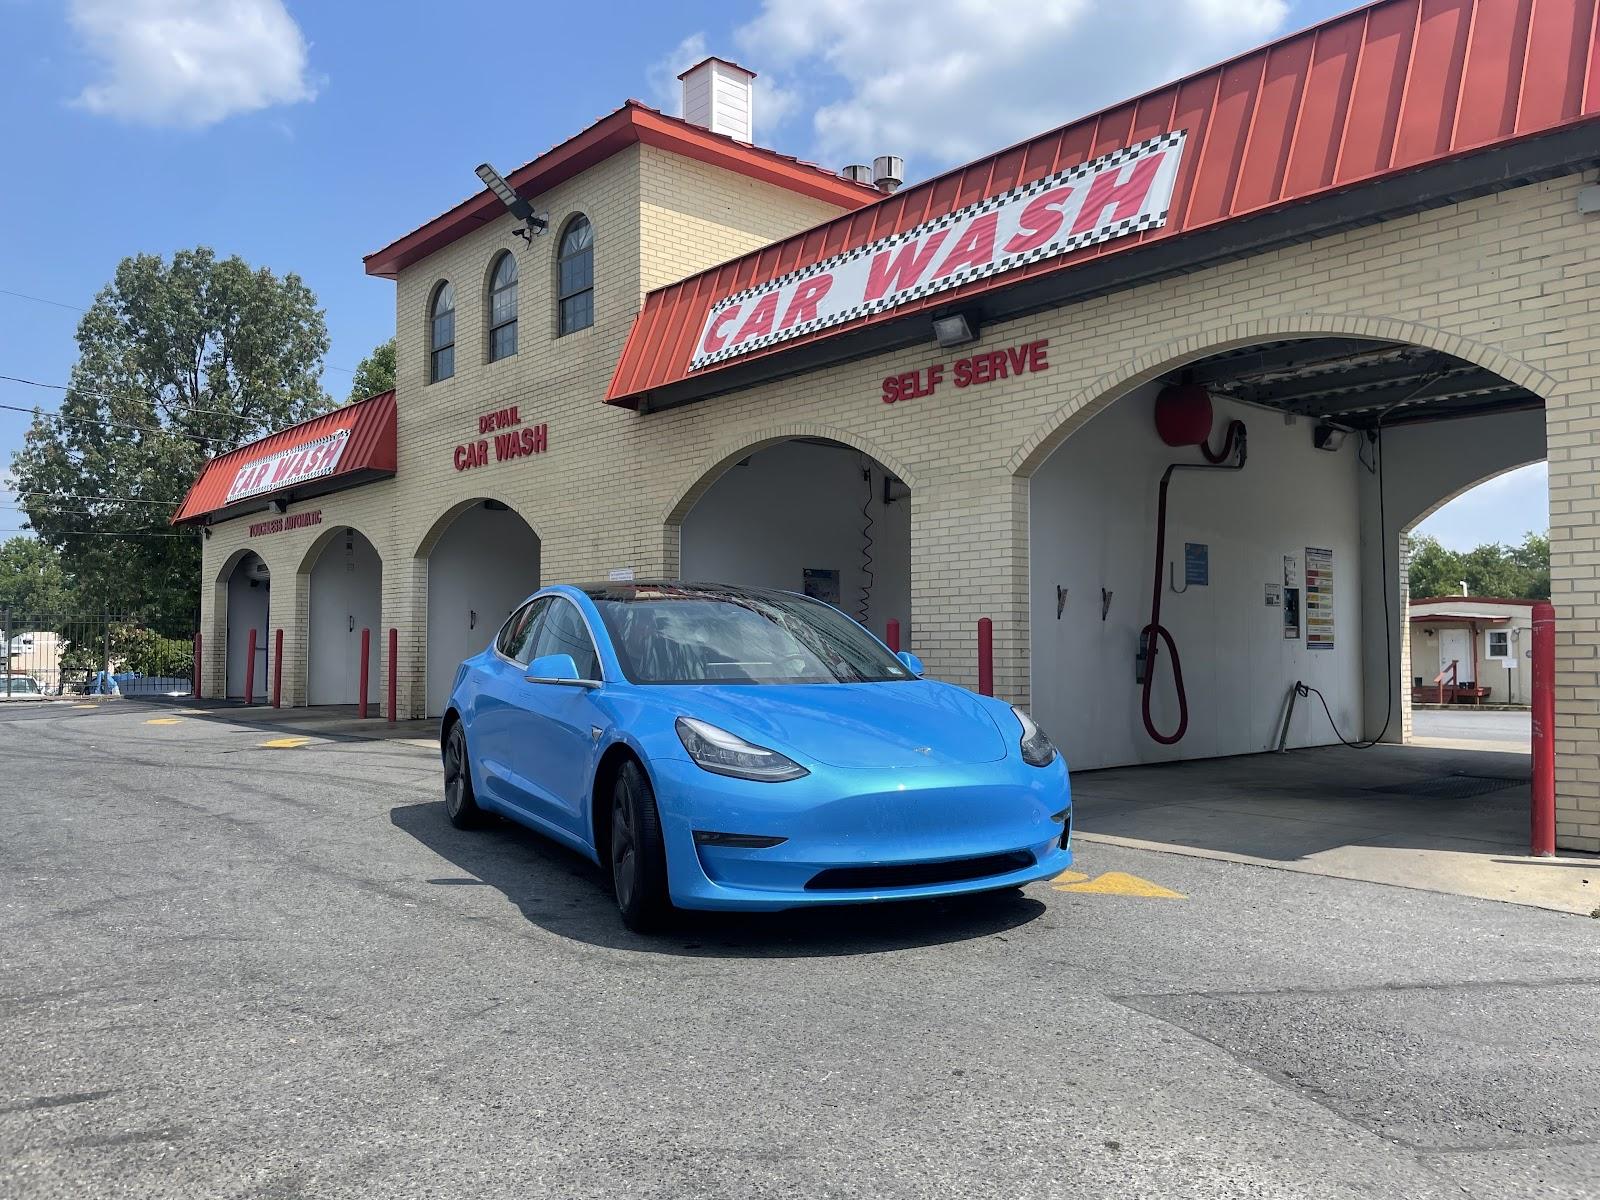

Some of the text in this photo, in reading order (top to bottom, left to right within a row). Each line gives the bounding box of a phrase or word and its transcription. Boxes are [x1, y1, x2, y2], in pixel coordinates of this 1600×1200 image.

[703, 151, 1167, 354] CAR WASH
[882, 338, 1049, 404] SELF SERVE
[479, 406, 521, 434] DEVAIL
[230, 437, 345, 496] CAR WASH
[454, 424, 547, 471] CAR WASH
[249, 510, 322, 537] TOUCHLESS AUTOMATIC
